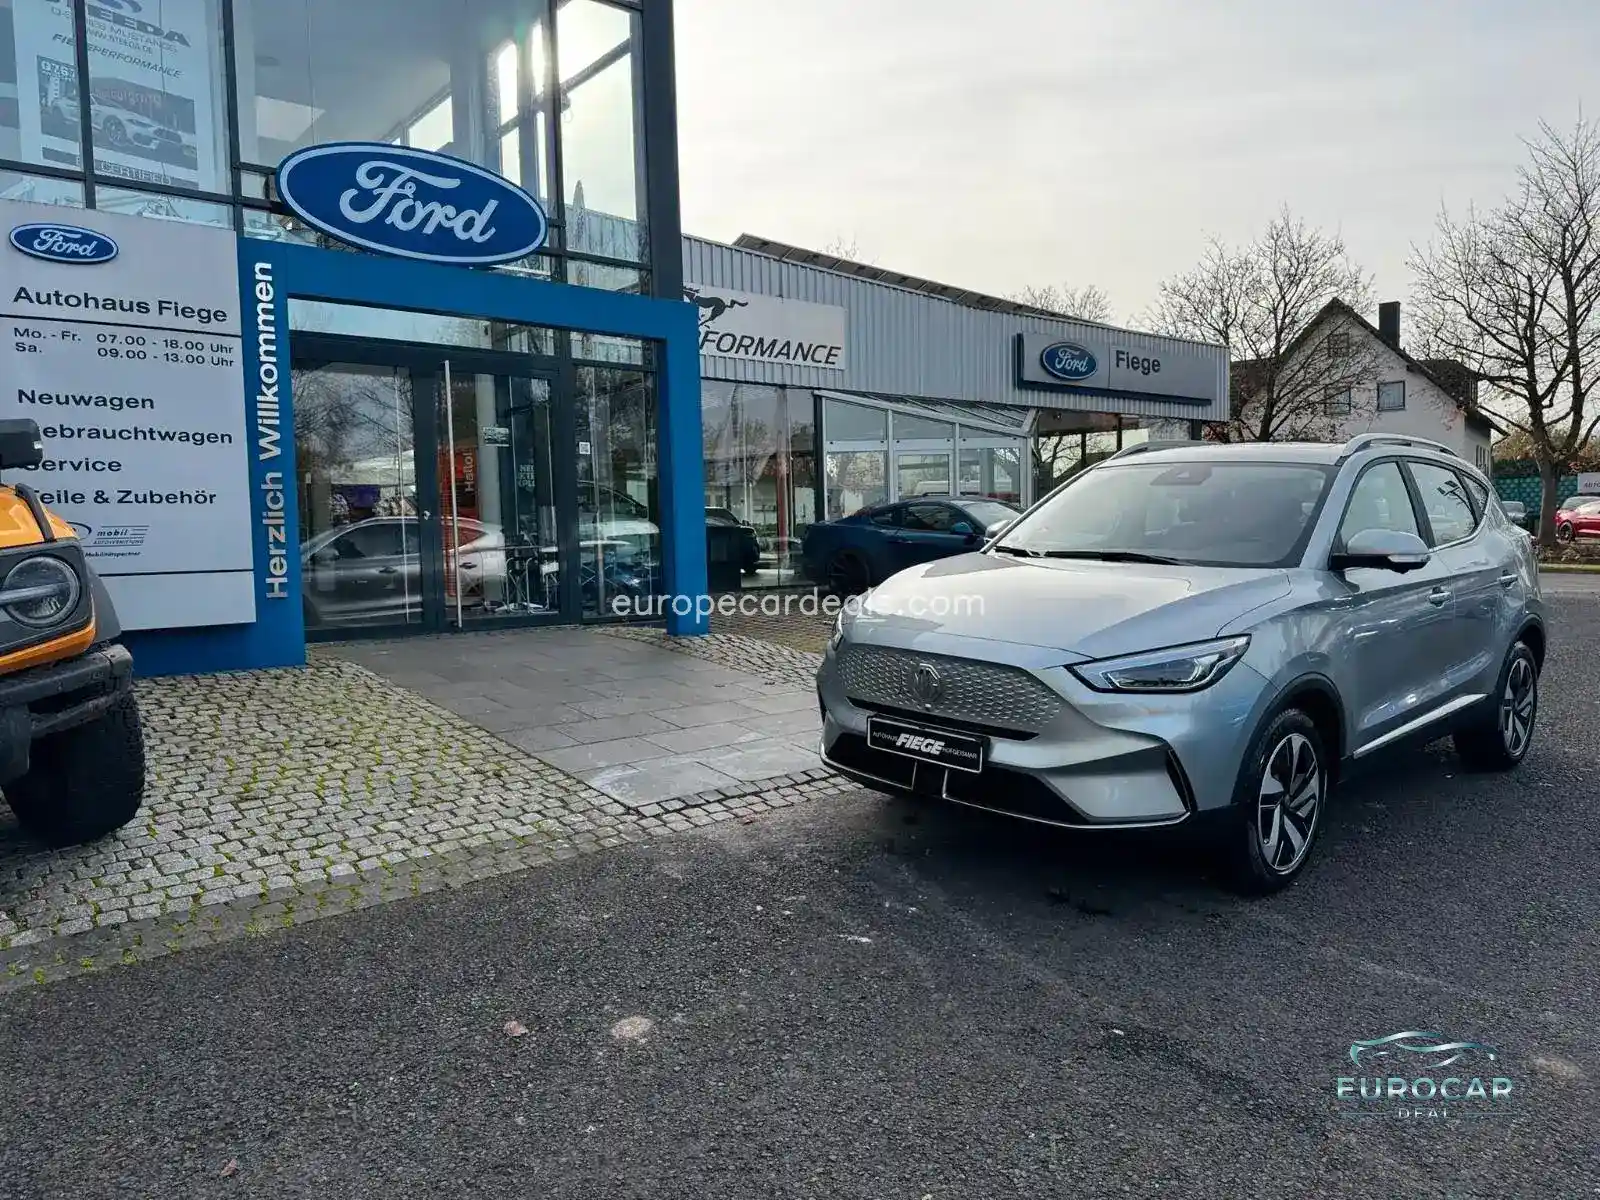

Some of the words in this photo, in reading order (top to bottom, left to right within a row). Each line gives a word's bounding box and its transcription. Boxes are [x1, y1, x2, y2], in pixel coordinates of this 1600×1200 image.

[339, 160, 499, 243] Ford
[33, 229, 97, 256] Ford
[13, 286, 151, 314] Autohaus
[157, 300, 228, 324] Fiege
[13, 327, 47, 339] Mo.
[61, 330, 82, 342] Fr.
[96, 333, 146, 347] 07.00
[163, 338, 205, 352] 18.00
[210, 342, 234, 354] Uhr
[698, 330, 842, 365] FORMANCE
[15, 342, 42, 353] Sa.
[97, 347, 147, 361] 09.00
[163, 352, 206, 366] 13.00
[210, 357, 235, 368] Uhr
[254, 261, 283, 461] Willkommen
[1055, 348, 1088, 373] Ford
[1115, 349, 1161, 376] Fiege
[17, 388, 155, 411] Neuwagen
[42, 423, 233, 446] ebrauchtwagen
[34, 489, 86, 505] eile
[93, 489, 110, 505] &
[116, 489, 217, 505] Zubehör
[97, 529, 128, 537] mobil
[262, 471, 288, 598] Herzlich
[895, 733, 946, 756] FIEGE
